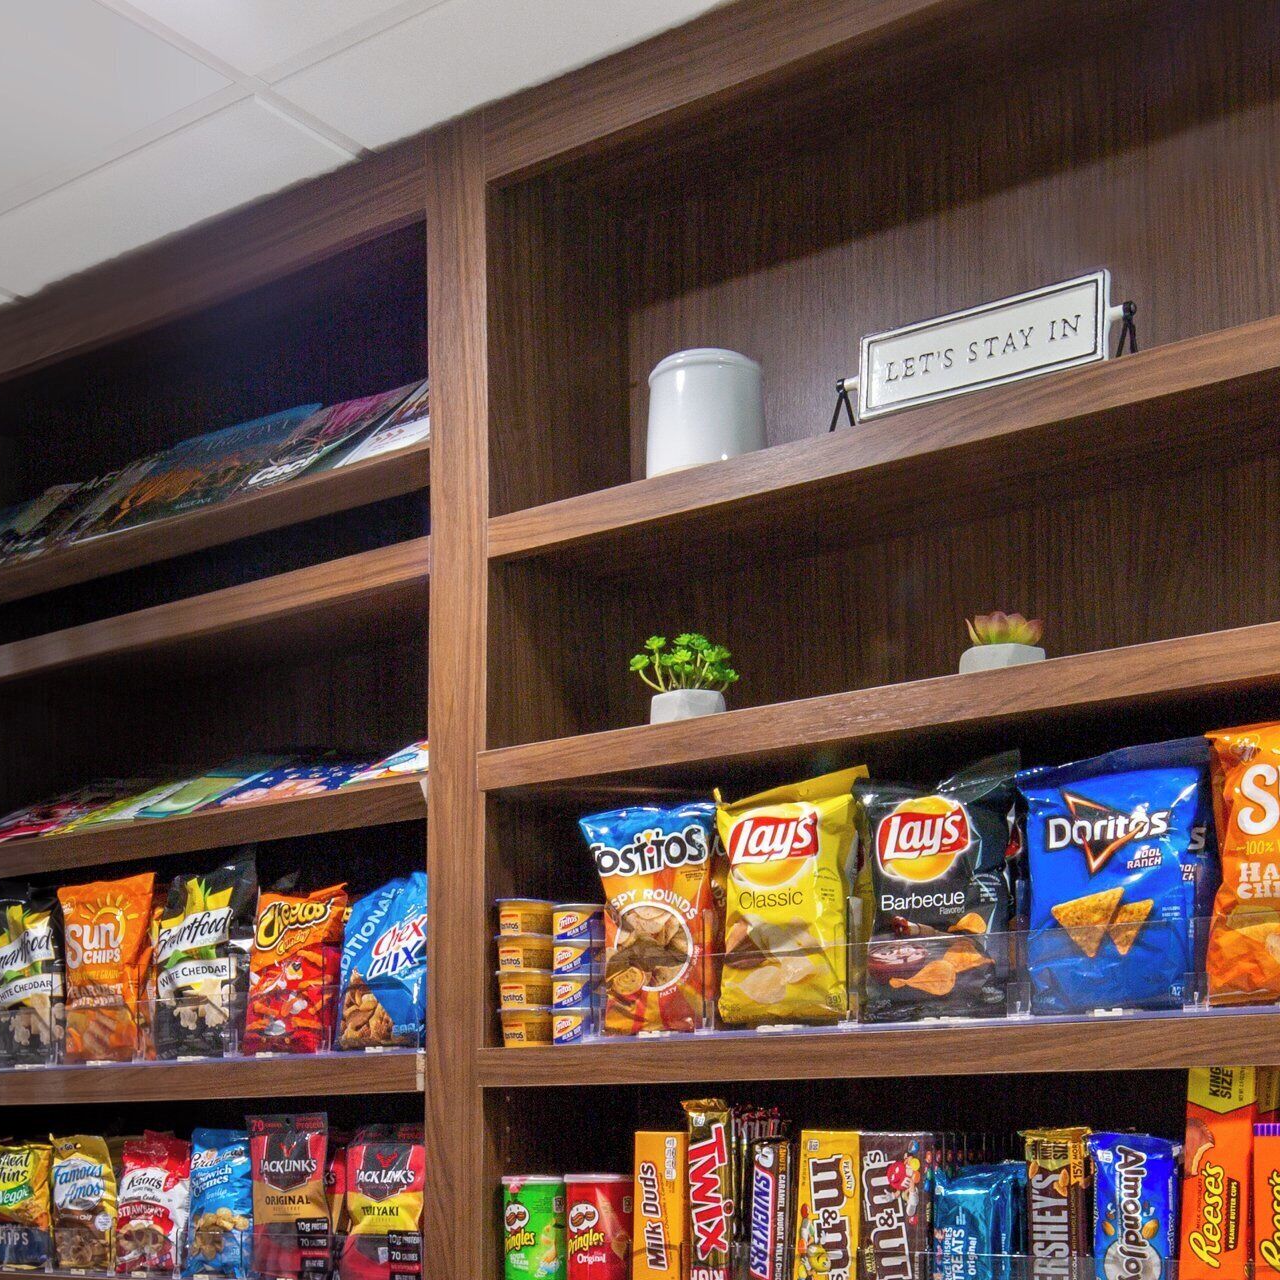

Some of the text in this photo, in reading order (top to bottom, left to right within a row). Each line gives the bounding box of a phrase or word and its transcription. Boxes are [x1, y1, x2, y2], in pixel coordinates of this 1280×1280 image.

[885, 315, 1082, 383] LET'S STAY IN
[731, 812, 818, 865] Lay's
[882, 809, 964, 861] Lay's
[1048, 810, 1170, 850] Doritos
[1244, 838, 1275, 855] 100%
[1126, 856, 1162, 869] RANCH
[643, 889, 698, 919] ROUNDS
[739, 888, 803, 909] Classic
[881, 890, 966, 912] Barbecue
[939, 904, 965, 915] Flavored
[66, 921, 125, 969] Sun
[372, 914, 427, 959] Chex
[82, 950, 121, 964] CHIPS
[181, 964, 228, 978] CHEDDAR
[19, 980, 52, 994] CHEDDAR
[1221, 1070, 1233, 1099] SIZE
[53, 1164, 103, 1182] Famous
[260, 1158, 317, 1174] JACK LINK'S
[842, 1160, 853, 1191] PEANUT
[1073, 1160, 1083, 1179] 15%
[58, 1185, 101, 1209] Amos
[265, 1195, 311, 1205] ORIGINAL
[1116, 1145, 1147, 1250] Almond
[361, 1206, 399, 1217] TERIYAKI
[639, 1161, 668, 1271] Milk Duds
[1189, 1161, 1225, 1269] Reese's
[297, 1222, 311, 1232] 10g
[750, 1170, 771, 1276] SNICKERS
[300, 1238, 310, 1247] 70
[389, 1234, 402, 1244] 10g
[943, 1227, 952, 1264] KRISPIES
[391, 1251, 400, 1261] 70
[576, 1252, 607, 1264] Original
[967, 1235, 977, 1276] original
